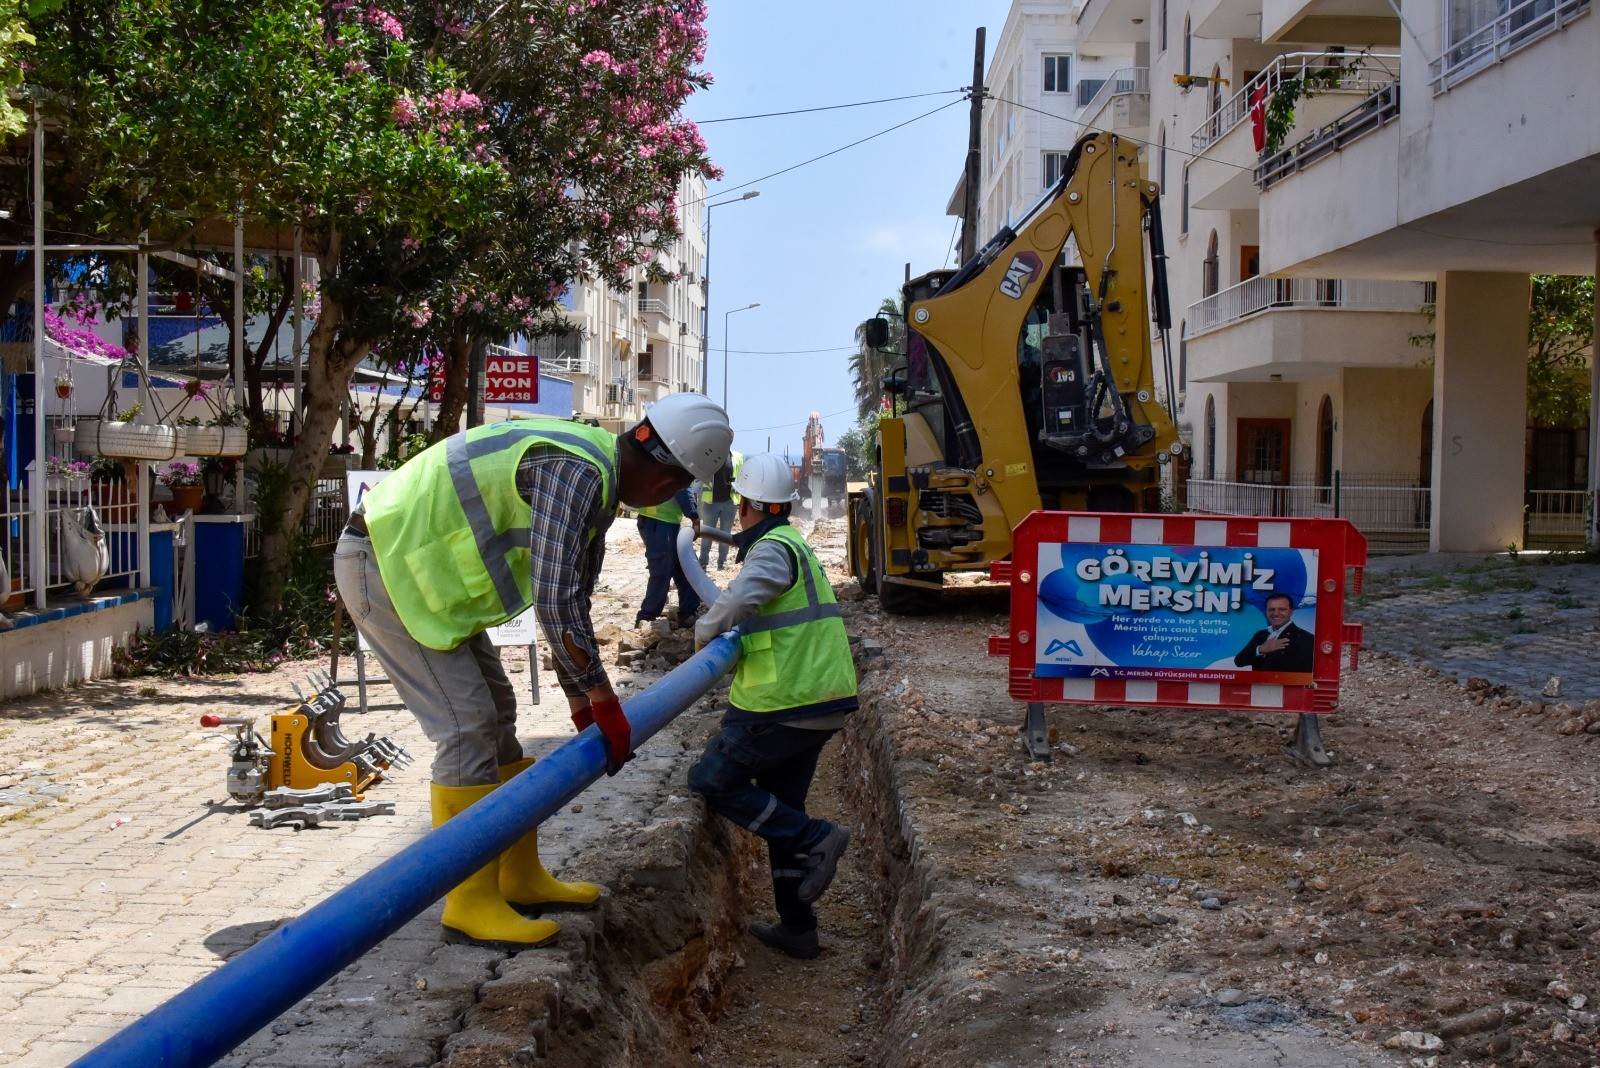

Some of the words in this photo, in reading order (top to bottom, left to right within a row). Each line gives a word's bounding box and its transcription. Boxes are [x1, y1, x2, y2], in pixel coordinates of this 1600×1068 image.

[1000, 257, 1034, 299] CAT
[1057, 370, 1075, 382] CAT
[1076, 548, 1274, 591] GÖREVİMİZ
[1099, 584, 1241, 613] MERSİN!
[1112, 615, 1130, 623] Her
[1133, 616, 1161, 625] yerde
[1179, 617, 1196, 625] her
[1199, 619, 1231, 627] şartta,
[1114, 624, 1148, 632] Mersin
[1151, 625, 1168, 635] için
[1201, 627, 1228, 635] başla
[1143, 633, 1198, 643] çalışıyoruz.
[1132, 643, 1169, 662] Vahap
[1172, 646, 1202, 659] Seçer
[1155, 671, 1197, 679] BÜYÜKŞEHİR
[1199, 672, 1235, 680] BELEDİYESİ
[283, 733, 292, 786] HOCHWELD
